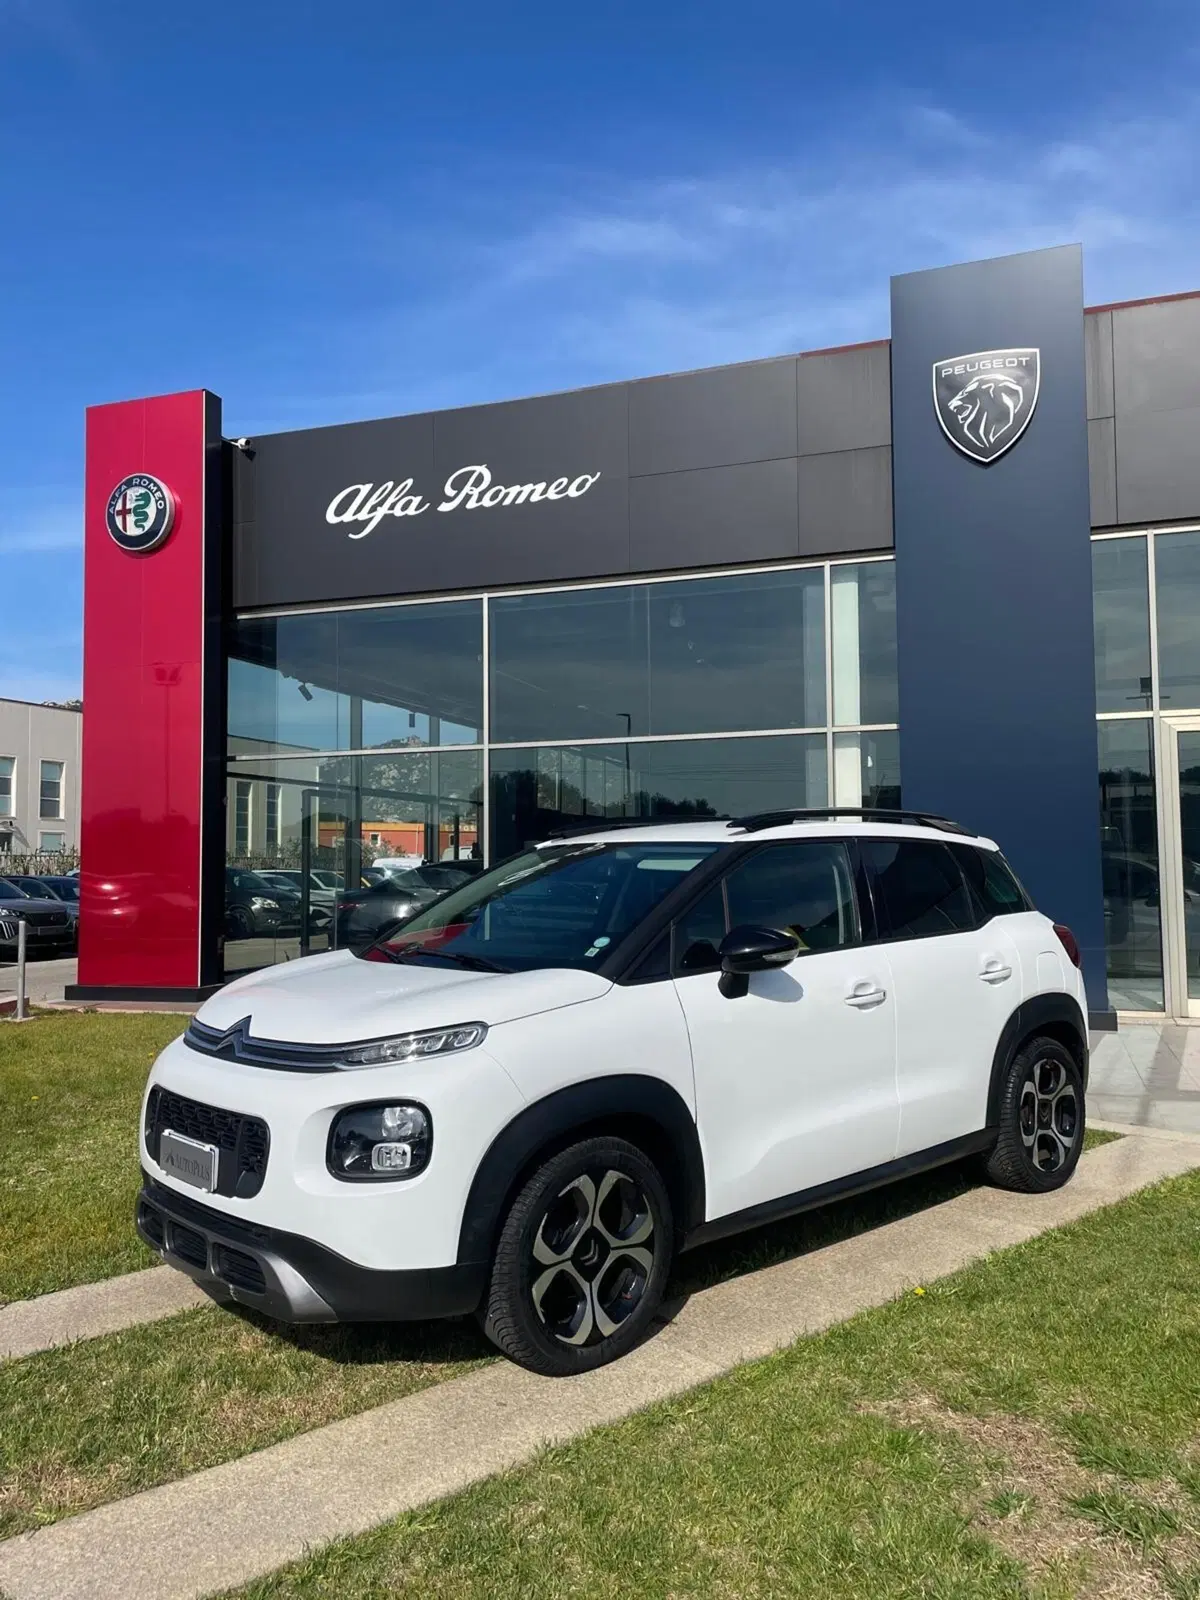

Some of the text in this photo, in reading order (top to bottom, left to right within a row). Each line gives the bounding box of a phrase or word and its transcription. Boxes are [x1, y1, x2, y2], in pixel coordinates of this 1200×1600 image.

[941, 357, 1031, 378] PEUGEOT
[109, 477, 165, 515] ALFA ROMEO
[325, 463, 601, 539] Alfa Romeo
